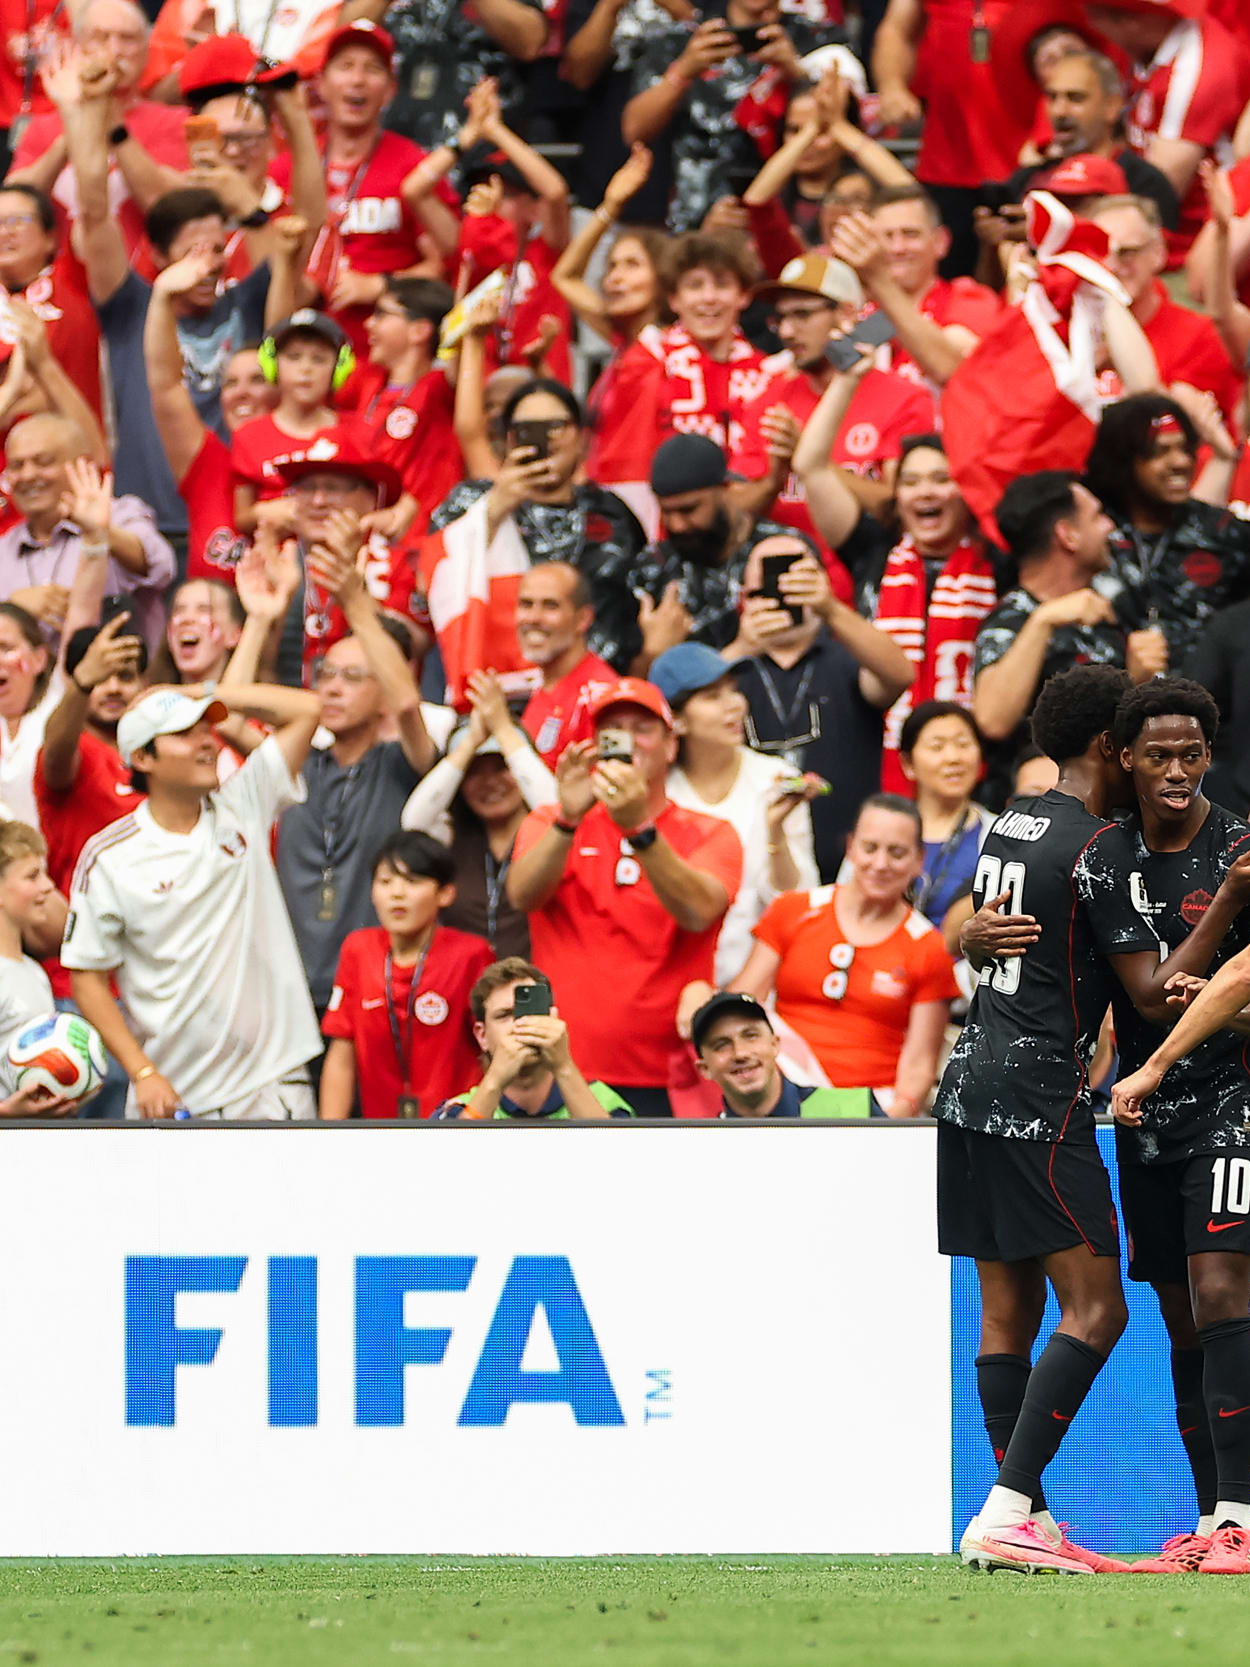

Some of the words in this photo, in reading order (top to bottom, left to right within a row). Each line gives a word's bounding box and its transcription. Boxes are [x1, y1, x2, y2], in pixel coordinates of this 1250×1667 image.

[992, 810, 1052, 842] AHMED
[1181, 902, 1209, 912] CANAD
[124, 1255, 627, 1427] FIFA
[644, 1368, 673, 1425] TM
